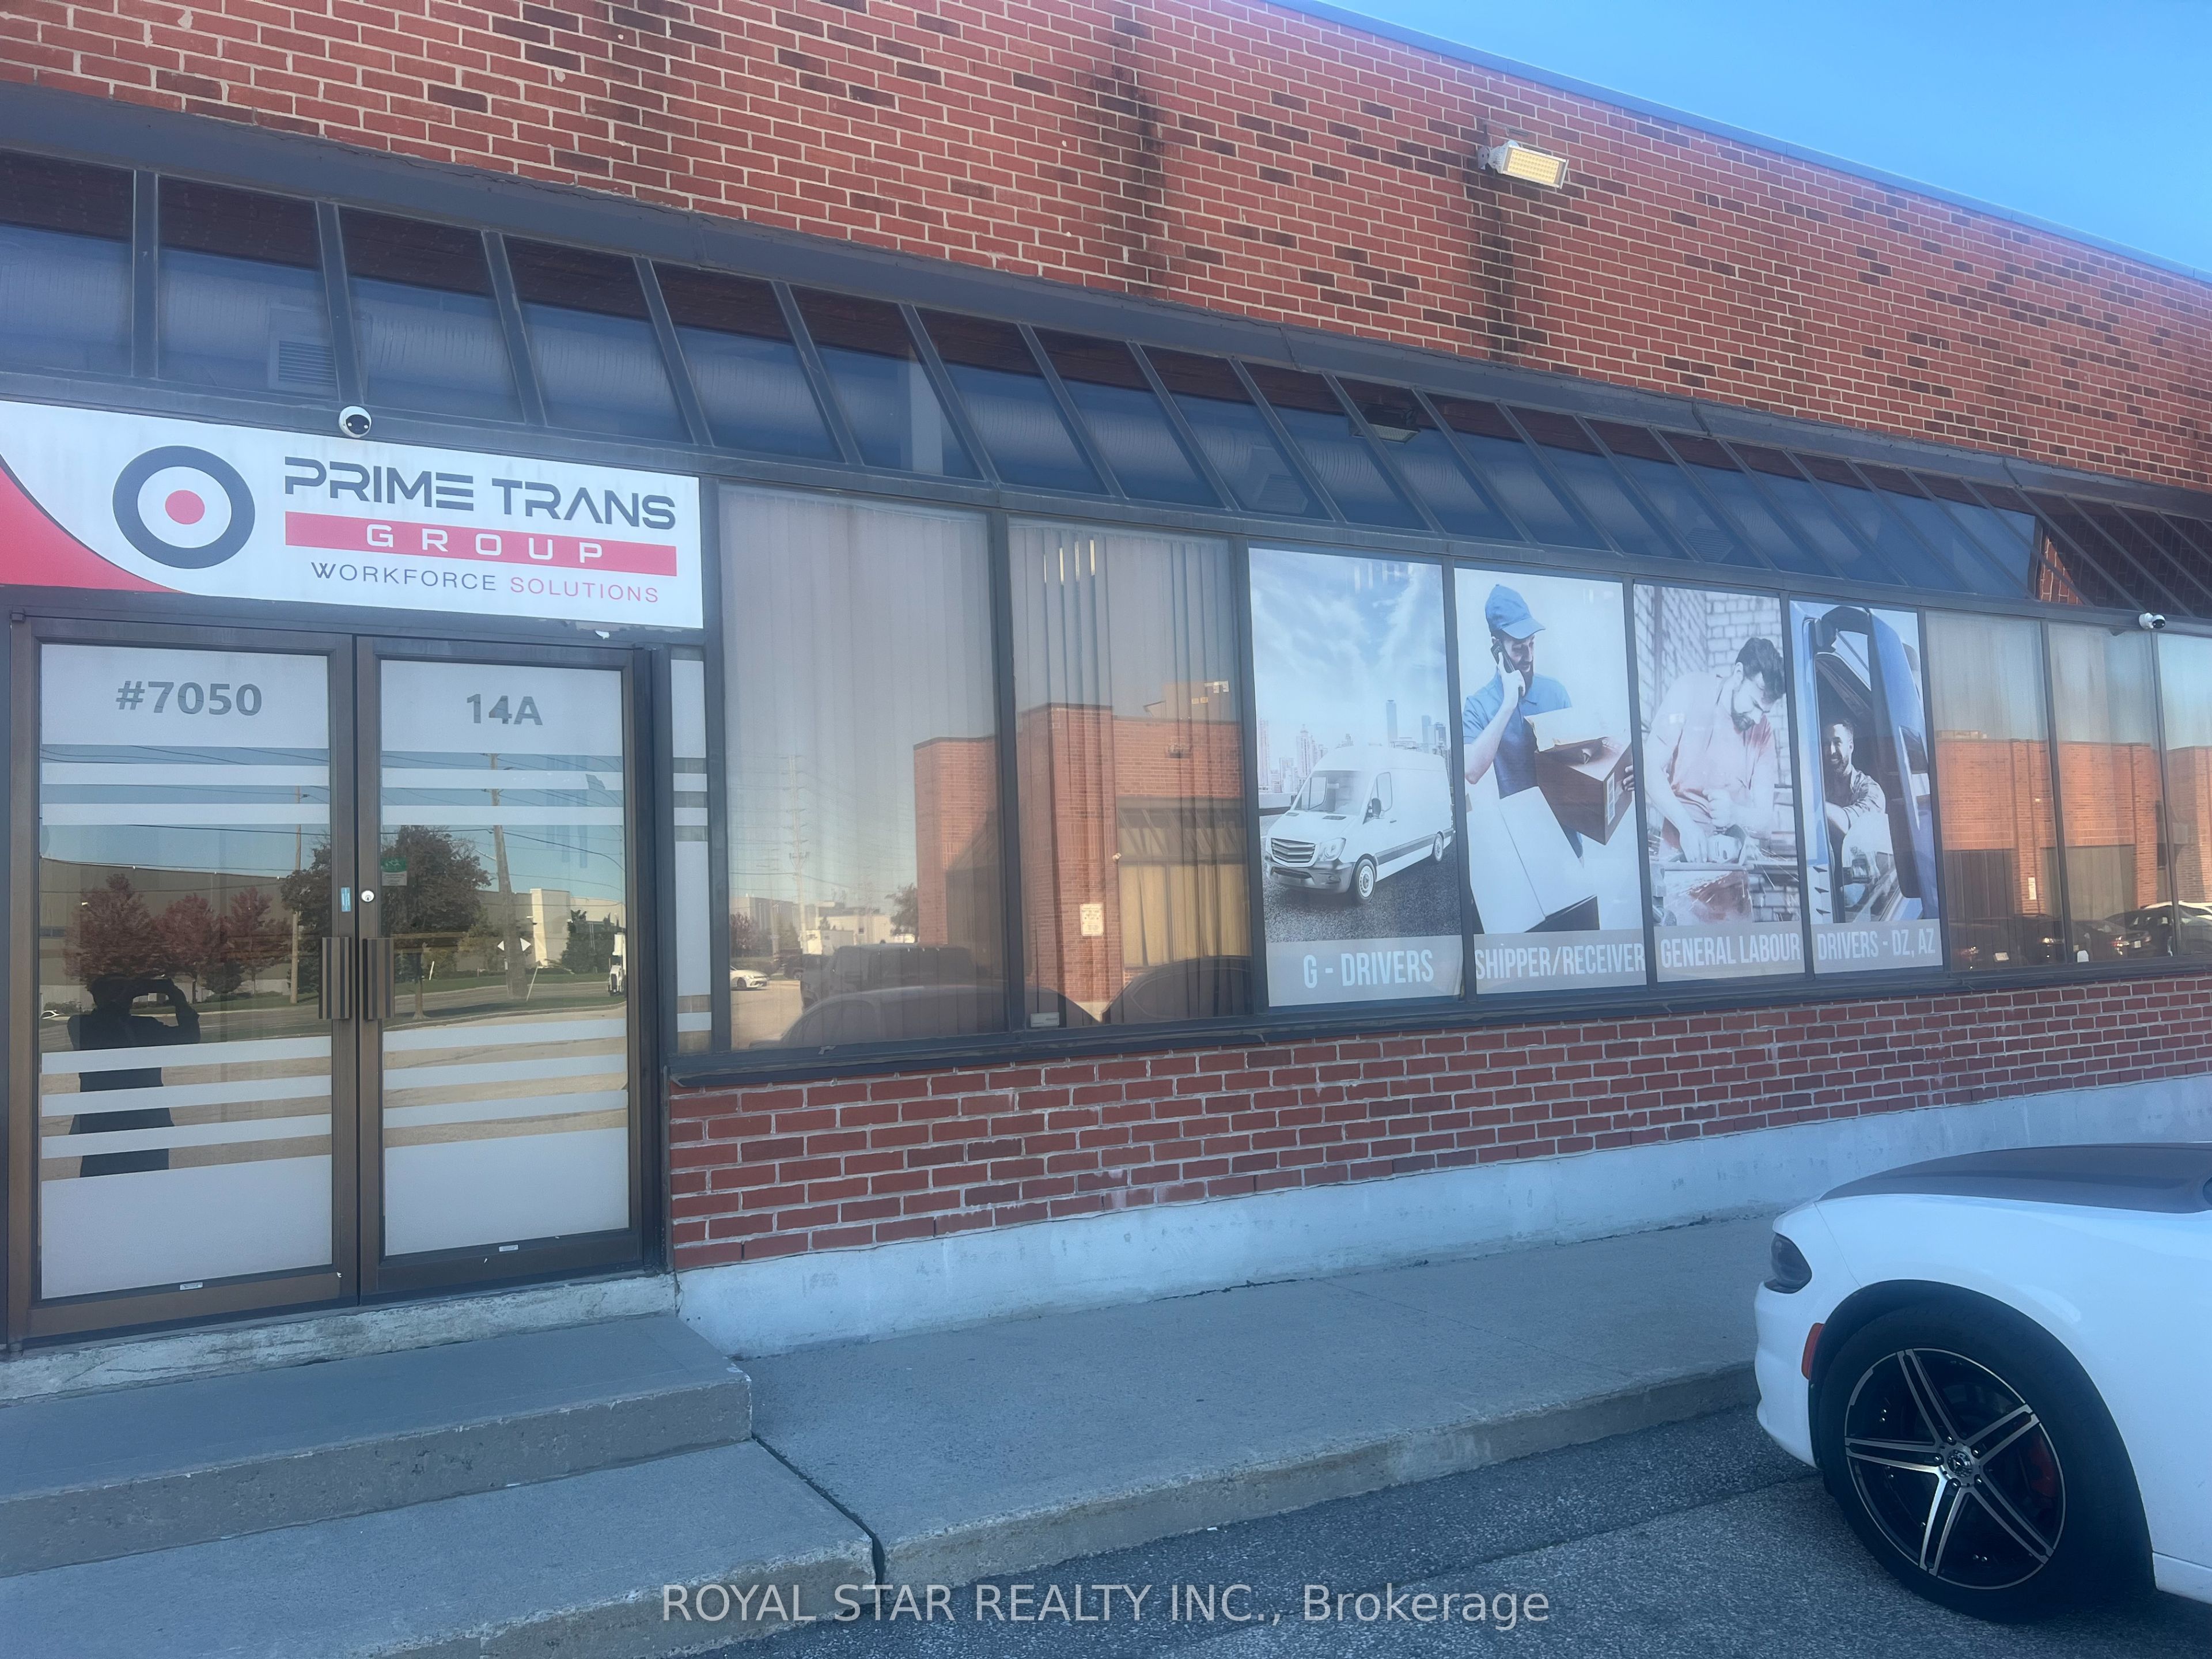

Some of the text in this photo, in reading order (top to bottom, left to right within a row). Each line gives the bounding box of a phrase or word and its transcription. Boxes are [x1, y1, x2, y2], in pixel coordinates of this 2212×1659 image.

[285, 456, 676, 530] PRIME TRANS
[366, 524, 603, 563] GROUP
[311, 562, 658, 603] WORKFORCE SOLUTIONS
[116, 680, 262, 716] #7050
[467, 694, 543, 726] 14A
[1660, 933, 1801, 968] GENERAL LABOUR
[1817, 930, 1879, 961] DRIVERS
[1918, 927, 1936, 954] AZ
[1303, 955, 1317, 988] G
[1340, 949, 1434, 987] DRIVERS
